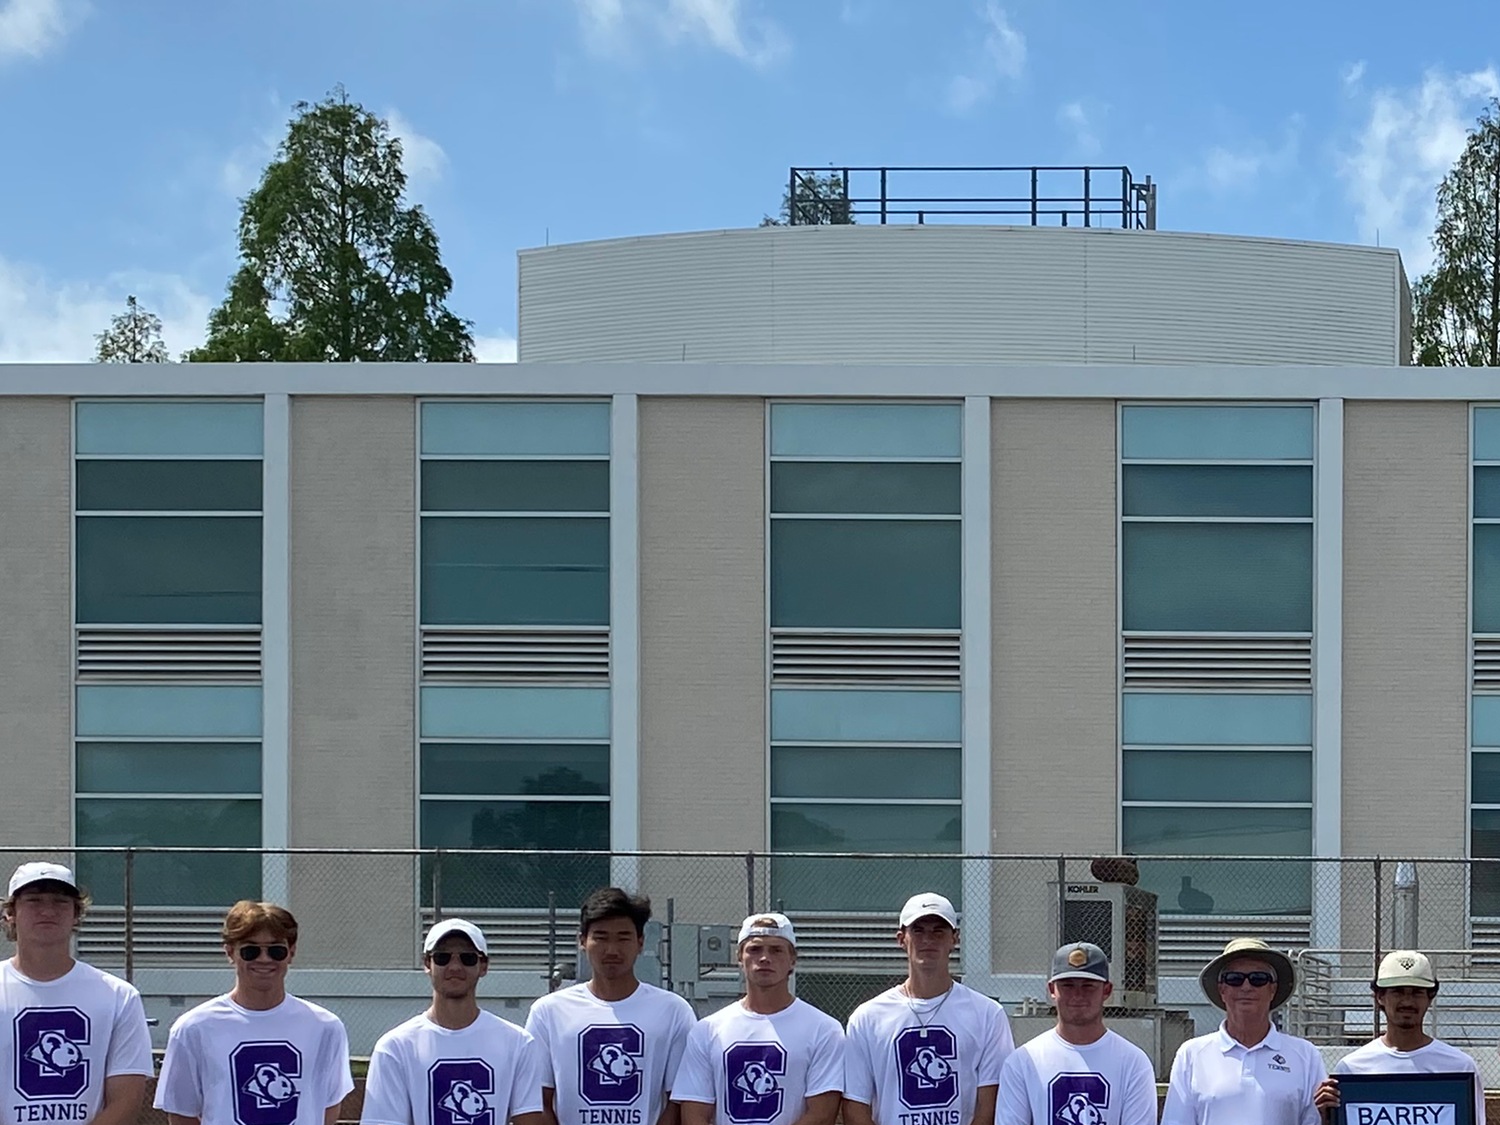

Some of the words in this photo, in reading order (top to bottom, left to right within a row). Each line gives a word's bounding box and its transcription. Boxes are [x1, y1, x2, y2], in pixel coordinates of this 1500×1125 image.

[1067, 885, 1099, 894] KOHLER
[14, 1104, 88, 1122] TENNIS
[579, 1109, 641, 1124] TENNIS
[1358, 1105, 1444, 1125] BARRY
